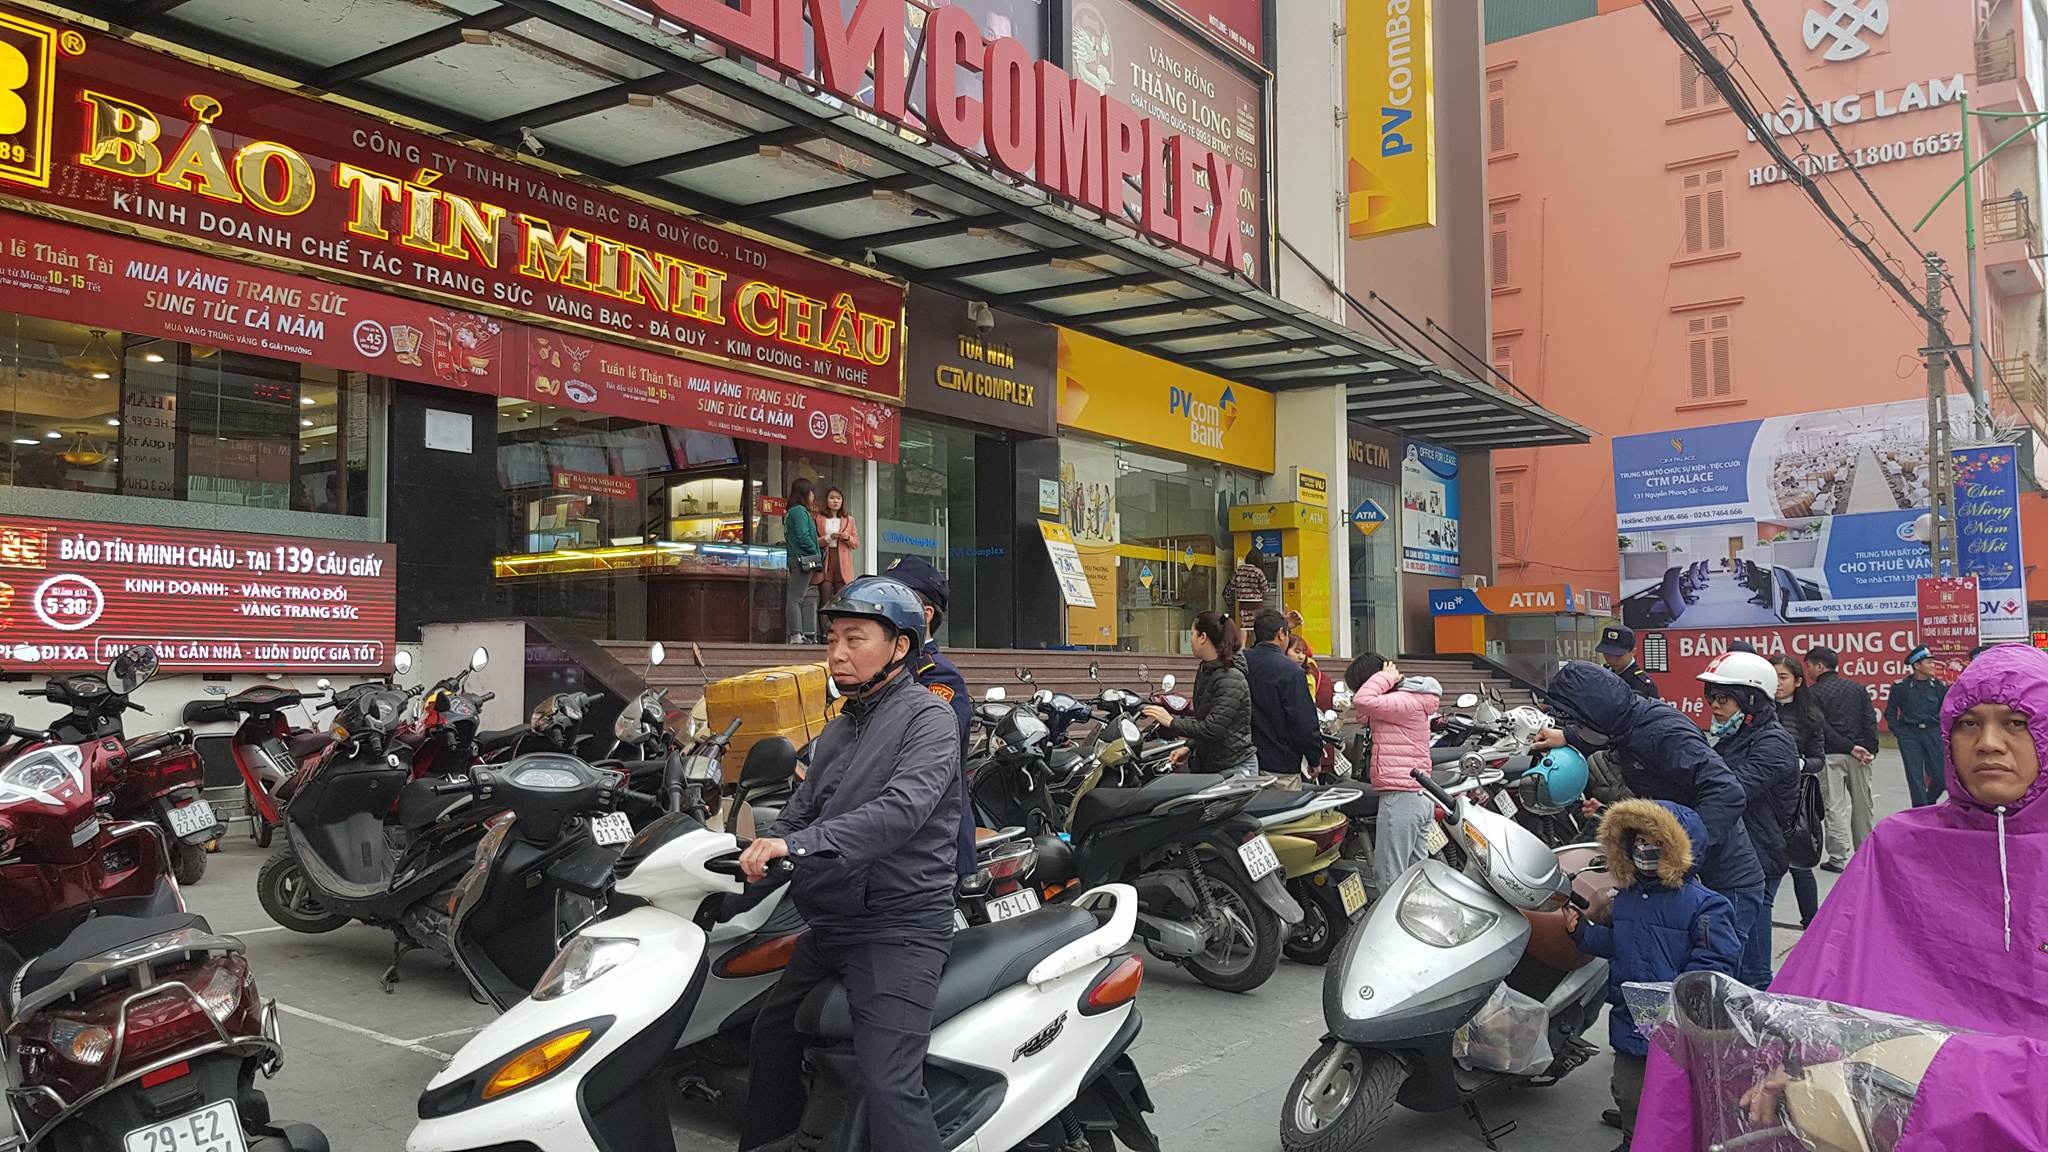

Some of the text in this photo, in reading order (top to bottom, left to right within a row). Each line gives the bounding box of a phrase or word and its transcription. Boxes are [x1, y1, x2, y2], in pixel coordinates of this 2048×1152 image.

[1149, 46, 1215, 99] VÀNG RỒNG
[1130, 61, 1188, 115] THĂNG
[1191, 97, 1233, 140] LONG
[1874, 73, 1966, 118] LAM
[926, 3, 1246, 272] COMPLEX
[1853, 140, 1906, 168] 1800
[352, 129, 421, 164] CÔNG
[432, 152, 458, 174] TY
[464, 162, 520, 194] TNHH
[526, 175, 578, 210] VÀNG
[584, 200, 620, 224] BẠC
[628, 213, 651, 234] ĐÁ
[657, 223, 691, 246] QUÝ
[79, 94, 896, 367] BẢO TÍN MINH CHÂU
[10, 238, 26, 258] lễ
[33, 242, 79, 269] Thần
[86, 253, 114, 275] Tài
[19, 269, 102, 293] Mùng 10 15 Tết
[112, 191, 869, 388] KINH DOANH CHẾ TÁC TRANG SỨC VÀNG BẠC ĐÁ QUÝ KIM CƯƠNG MỸ NGHỆ
[125, 260, 350, 318] MUA VÀNG TRANG SỨC
[144, 290, 325, 340] SUNG TÚC CẢ NĂM
[164, 321, 183, 334] MUA
[184, 324, 206, 338] VÀNG
[208, 327, 235, 342] TRÚNG
[236, 333, 258, 347] VÀNG
[260, 338, 268, 349] 6
[366, 333, 382, 346] 45
[987, 342, 1015, 370] NHÀ
[648, 386, 656, 398] 10
[660, 389, 668, 400] 15
[687, 376, 807, 411] MUA VÀNG TRANG SỨC
[975, 373, 1035, 408] COMPLEX
[697, 397, 794, 429] SUNG TÚC CẢ NĂM
[1169, 385, 1220, 427] PVcom
[1190, 420, 1225, 450] Bank
[1366, 443, 1391, 470] CTM
[1619, 471, 1641, 480] TRUNG
[1646, 471, 1714, 488] CTM PALACE
[1633, 492, 1645, 501] 131
[1668, 488, 1688, 498] Phong
[1966, 481, 2006, 499] Chúc
[1355, 511, 1377, 521] ATM
[1621, 517, 1645, 525] Hotline:
[1958, 500, 2014, 521] Mừng
[1963, 519, 2009, 536] Năm
[60, 533, 102, 562] BẢO
[104, 537, 134, 563] TÍN
[137, 543, 185, 568] MINH
[188, 544, 236, 571] CHÂU
[247, 551, 271, 576] TẠI
[275, 545, 314, 575] 139
[316, 550, 347, 576] CẦU
[349, 552, 384, 578] GIẤY
[1839, 562, 1868, 574] CHO
[1869, 557, 1904, 573] THUÊ
[1903, 557, 1933, 571] VĂN
[1855, 549, 1897, 559] TRUNG TÂM
[125, 578, 349, 602] KINH DOANH: VÀNG TRAO ĐỔI
[1868, 575, 1884, 584] nhà
[1883, 575, 1901, 584] CTM
[241, 602, 360, 621] VÀNG TRANG SỨC
[1434, 601, 1457, 611] VIB
[1509, 591, 1556, 609] ATM
[1795, 604, 1822, 614] Hotline:
[41, 645, 89, 660] ĐI XA
[179, 640, 377, 664] GẦN NHÀ LUÔN ĐƯỢC GIÁ TỐT
[1679, 631, 1728, 658] BÁN
[1791, 631, 1883, 656] CHUNG
[1842, 656, 1879, 676] CẦU
[1681, 696, 1704, 717] hệ
[174, 804, 206, 822] 29-P1
[175, 813, 213, 835] 221.66
[596, 827, 635, 843] 313.16
[1242, 839, 1268, 863] 29-B1
[994, 892, 1033, 921] 29-L1
[143, 1109, 225, 1152] 29-E2
